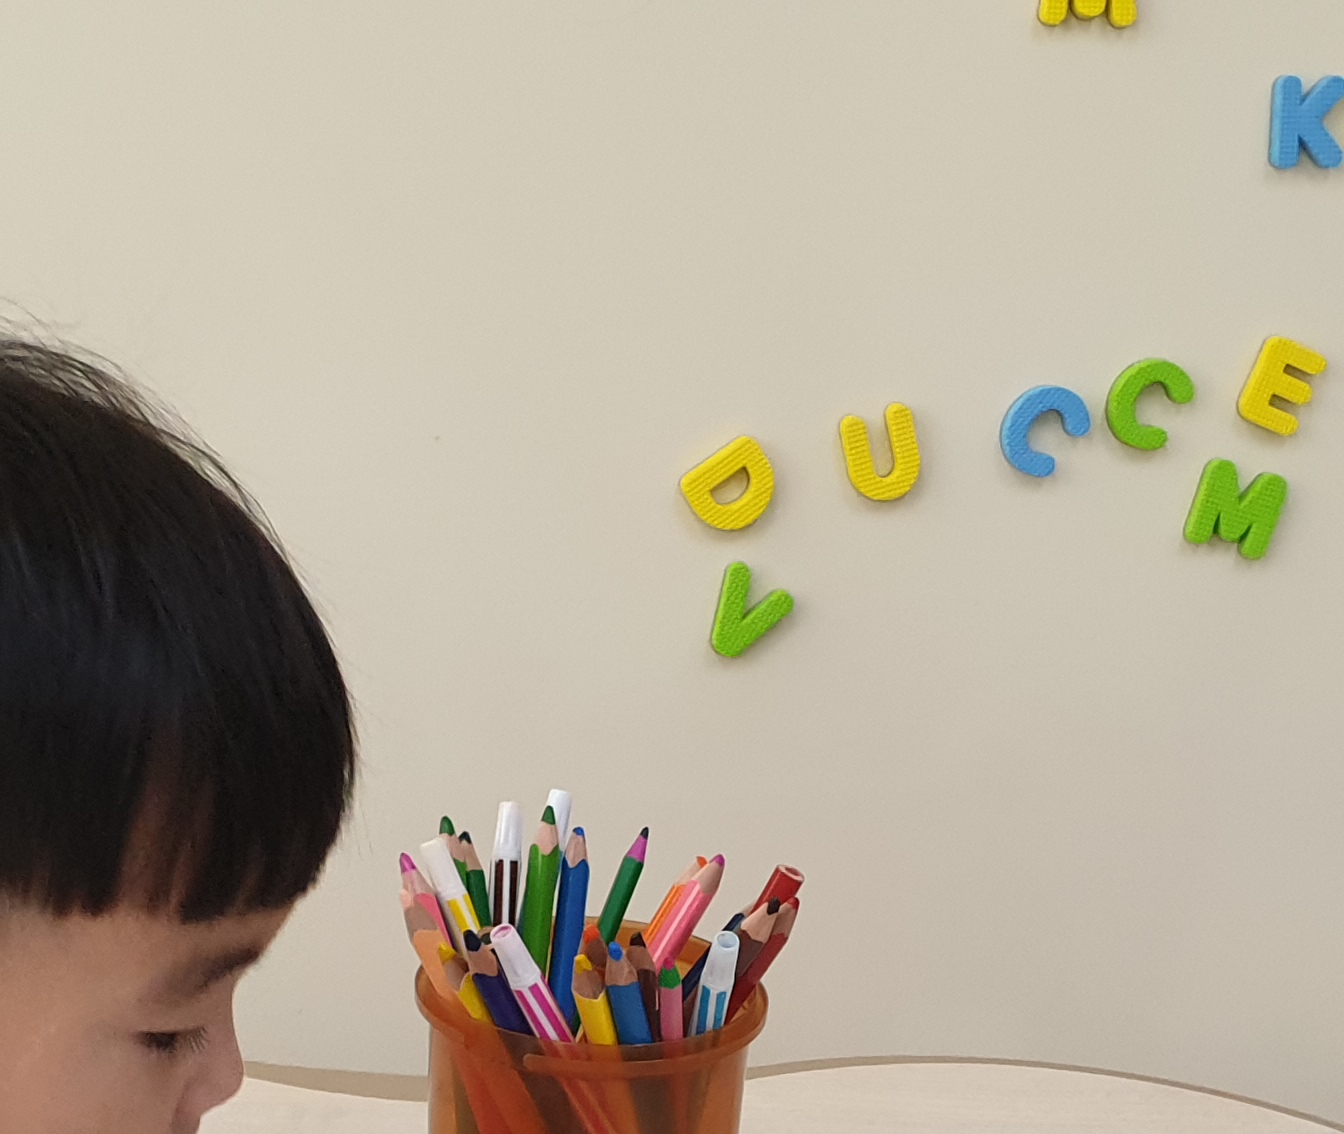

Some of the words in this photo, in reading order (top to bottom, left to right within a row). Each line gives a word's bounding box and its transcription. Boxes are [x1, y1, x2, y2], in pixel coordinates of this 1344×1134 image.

[1000, 384, 1092, 478] C
[1105, 357, 1196, 453] C
[1236, 335, 1329, 438] E
[679, 435, 776, 534] D
[838, 402, 923, 504] U
[1182, 458, 1289, 561] M
[709, 561, 795, 659] V
